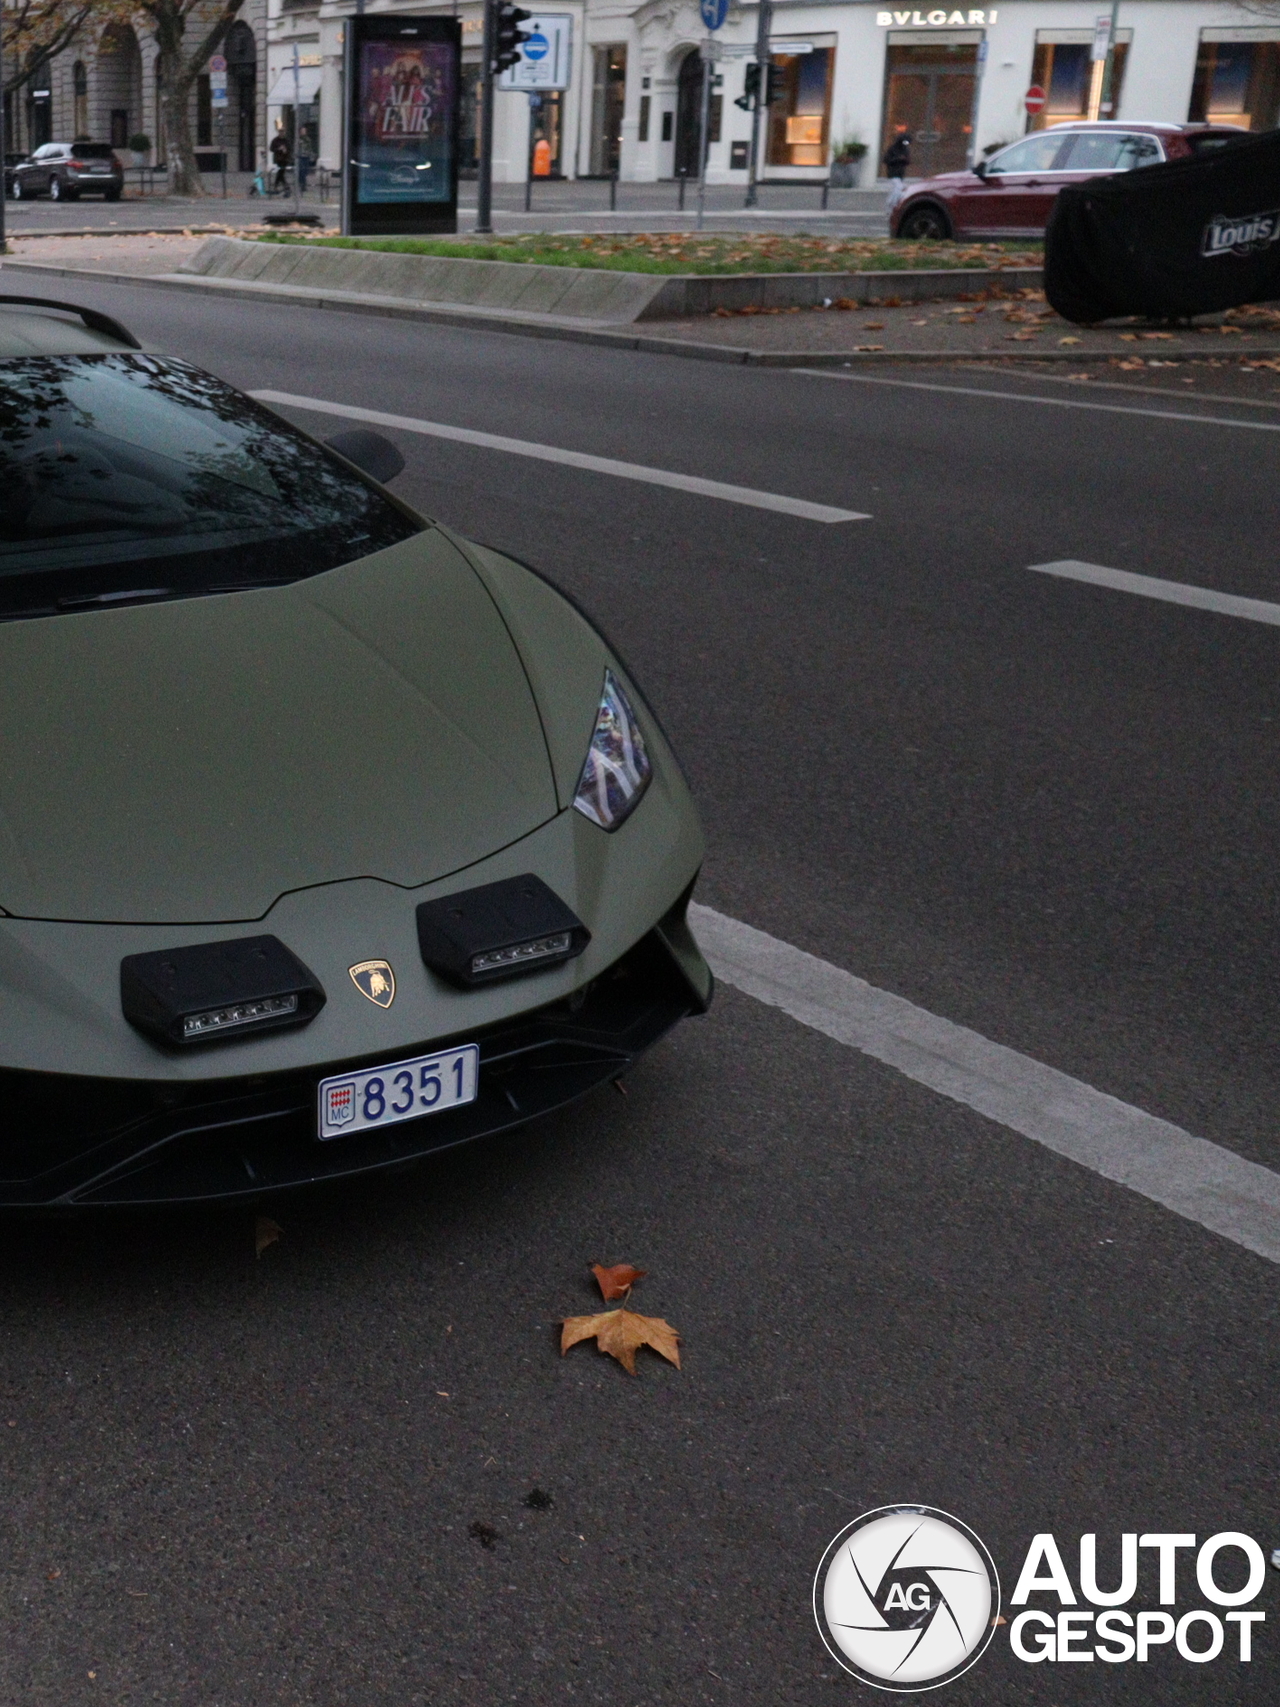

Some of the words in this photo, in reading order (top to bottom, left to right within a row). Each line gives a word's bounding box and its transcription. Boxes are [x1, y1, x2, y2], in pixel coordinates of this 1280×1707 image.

[876, 10, 998, 26] BVLGARI
[382, 107, 432, 132] FAIR
[1211, 217, 1273, 249] Louis
[331, 1106, 349, 1121] MC
[363, 1056, 463, 1120] 8351
